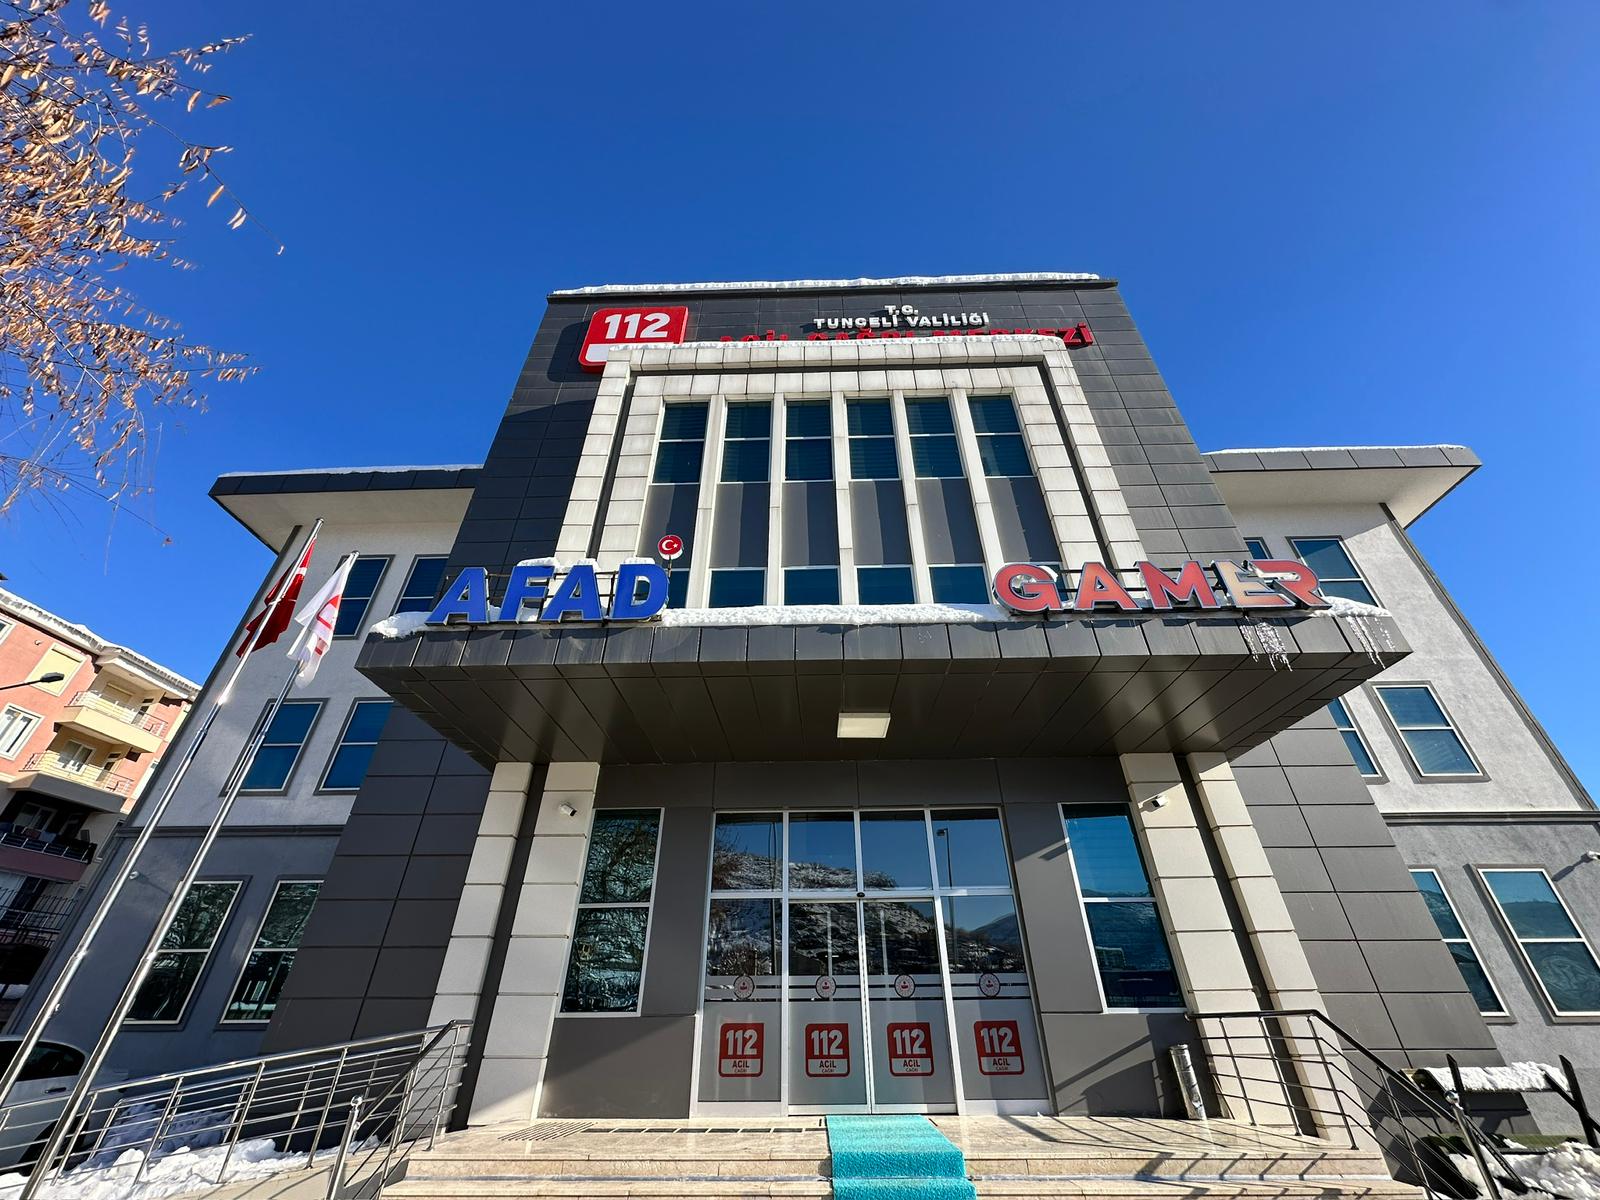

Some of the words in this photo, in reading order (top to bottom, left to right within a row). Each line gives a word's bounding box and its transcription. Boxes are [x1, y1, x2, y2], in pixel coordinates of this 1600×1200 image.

[604, 312, 671, 340] 112
[813, 314, 899, 329] TUNCELİ
[906, 312, 990, 328] VALİLİĞİ
[424, 563, 670, 625] AFAD
[992, 559, 1333, 613] GAMER
[726, 1029, 758, 1056] 112
[811, 1029, 844, 1056] 112
[893, 1028, 927, 1055] 112
[980, 1026, 1016, 1054] 112
